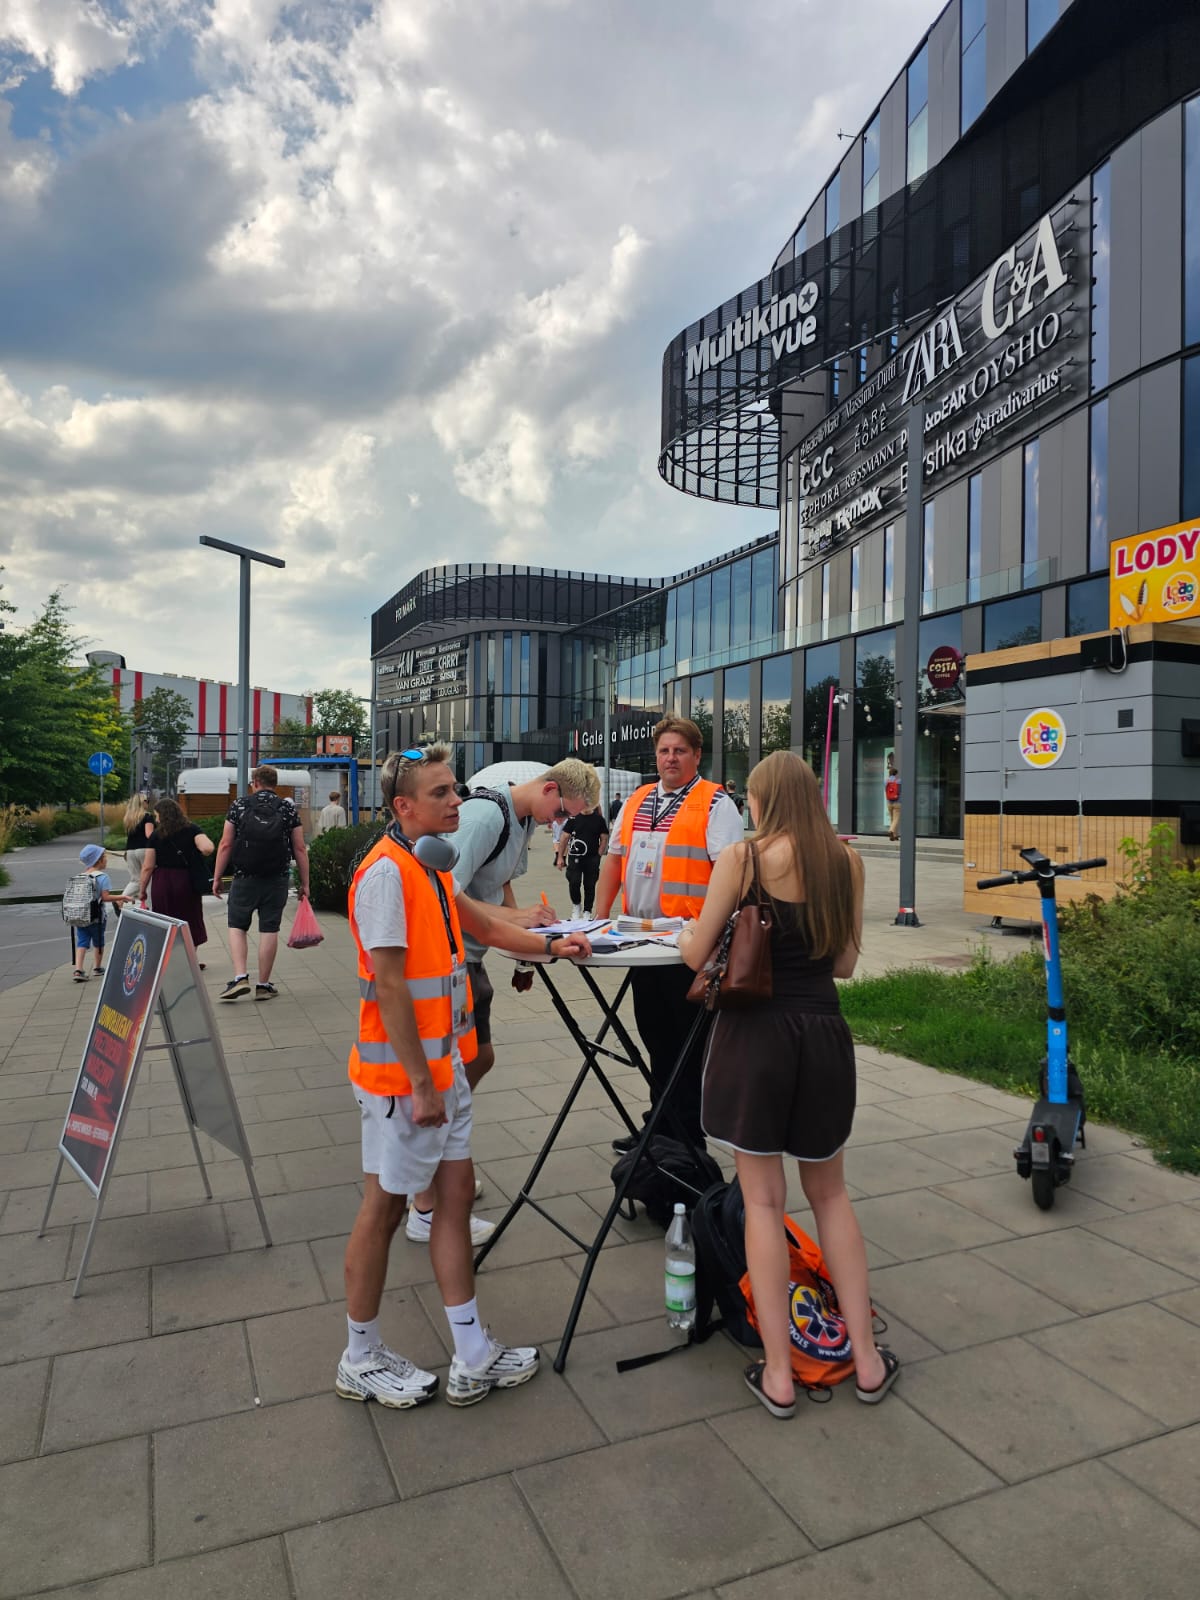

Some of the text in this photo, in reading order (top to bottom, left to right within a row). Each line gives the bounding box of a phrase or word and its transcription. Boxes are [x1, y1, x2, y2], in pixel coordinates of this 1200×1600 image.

[981, 214, 1068, 340] C&A
[687, 281, 818, 381] Multikino
[771, 315, 817, 361] vue
[902, 303, 967, 406] ZARA
[971, 312, 1060, 400] OYSHO
[845, 362, 896, 420] Massimo Dutti
[854, 402, 887, 437] ZARA
[854, 417, 887, 452] HOME
[800, 446, 834, 498] CCC
[900, 431, 967, 493] Bshka
[801, 484, 840, 524] SEPHORA
[1116, 529, 1200, 577] LODY
[410, 674, 435, 688] GRAAF
[438, 652, 460, 670] CARRY
[929, 662, 957, 672] COSTA
[582, 720, 657, 748] Galea Młocin
